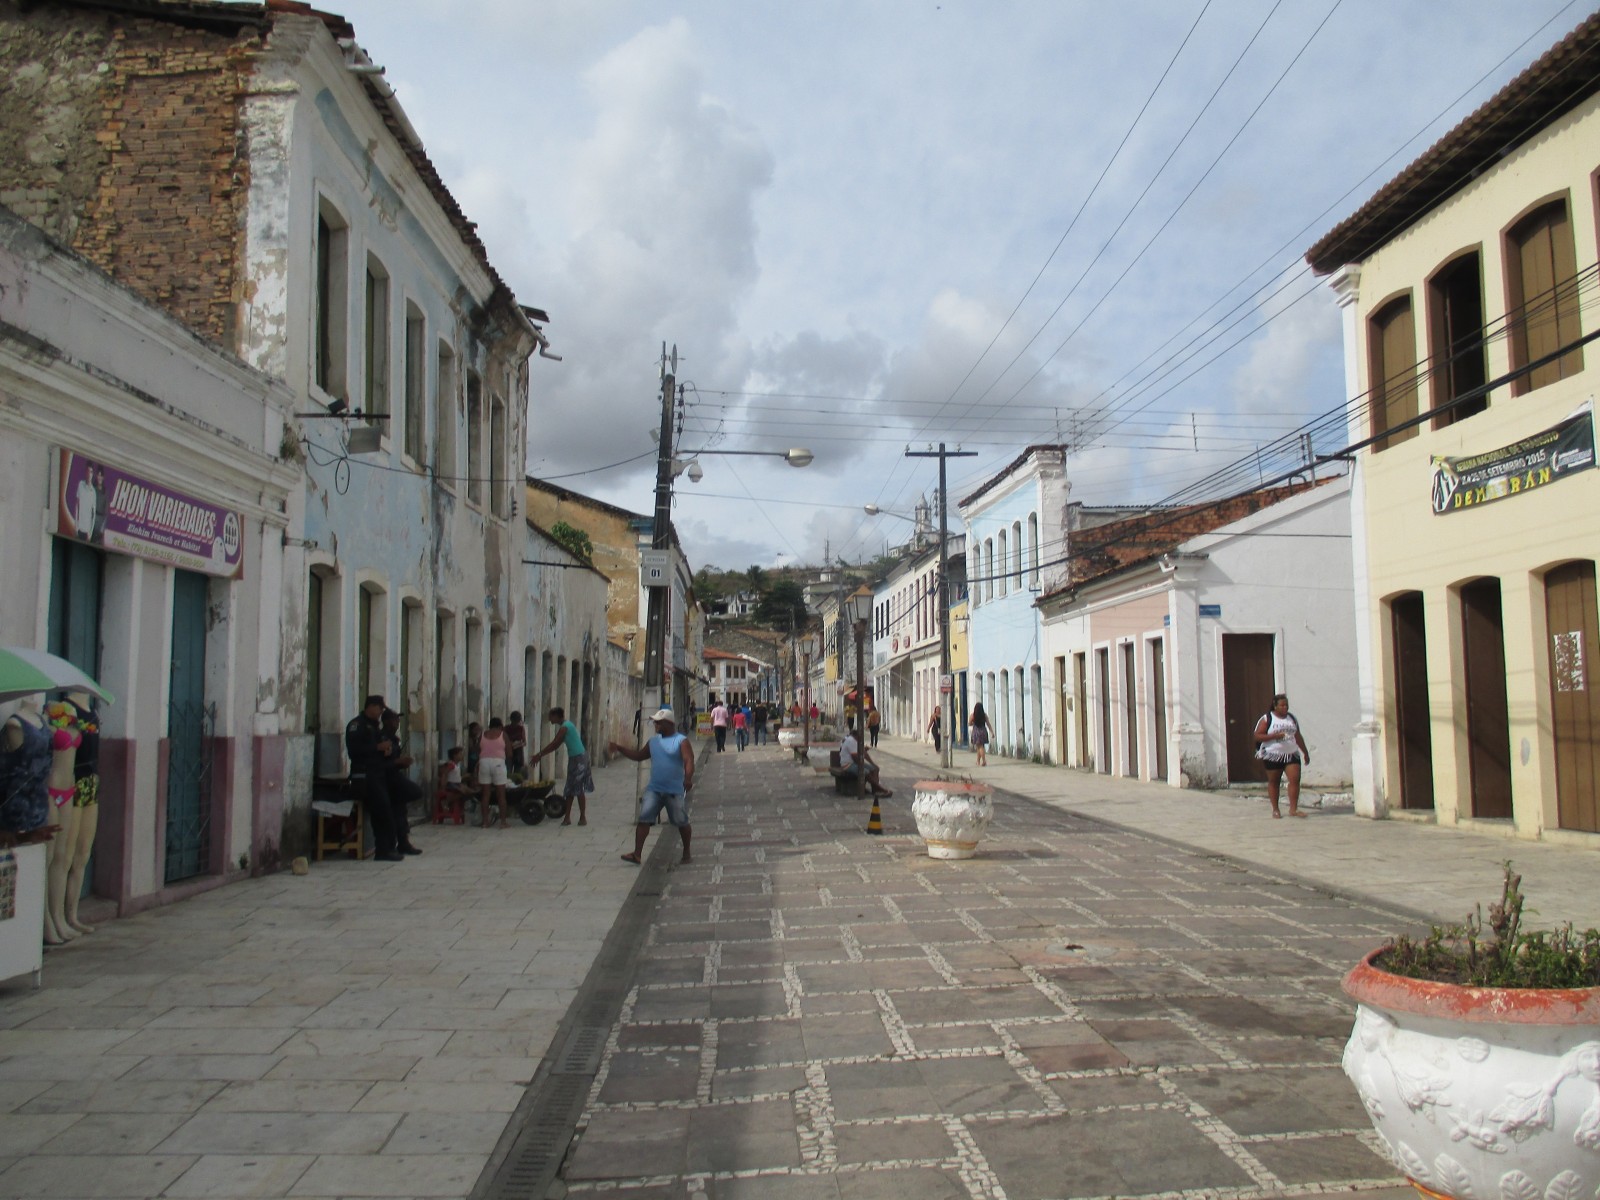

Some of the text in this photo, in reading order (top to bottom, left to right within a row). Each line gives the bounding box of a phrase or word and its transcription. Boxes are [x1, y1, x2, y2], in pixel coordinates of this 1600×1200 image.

[1487, 457, 1526, 478] SETEMBRO
[1526, 449, 1546, 466] 2015
[110, 478, 217, 541] JHON VARIEDADES
[651, 568, 660, 578] 01
